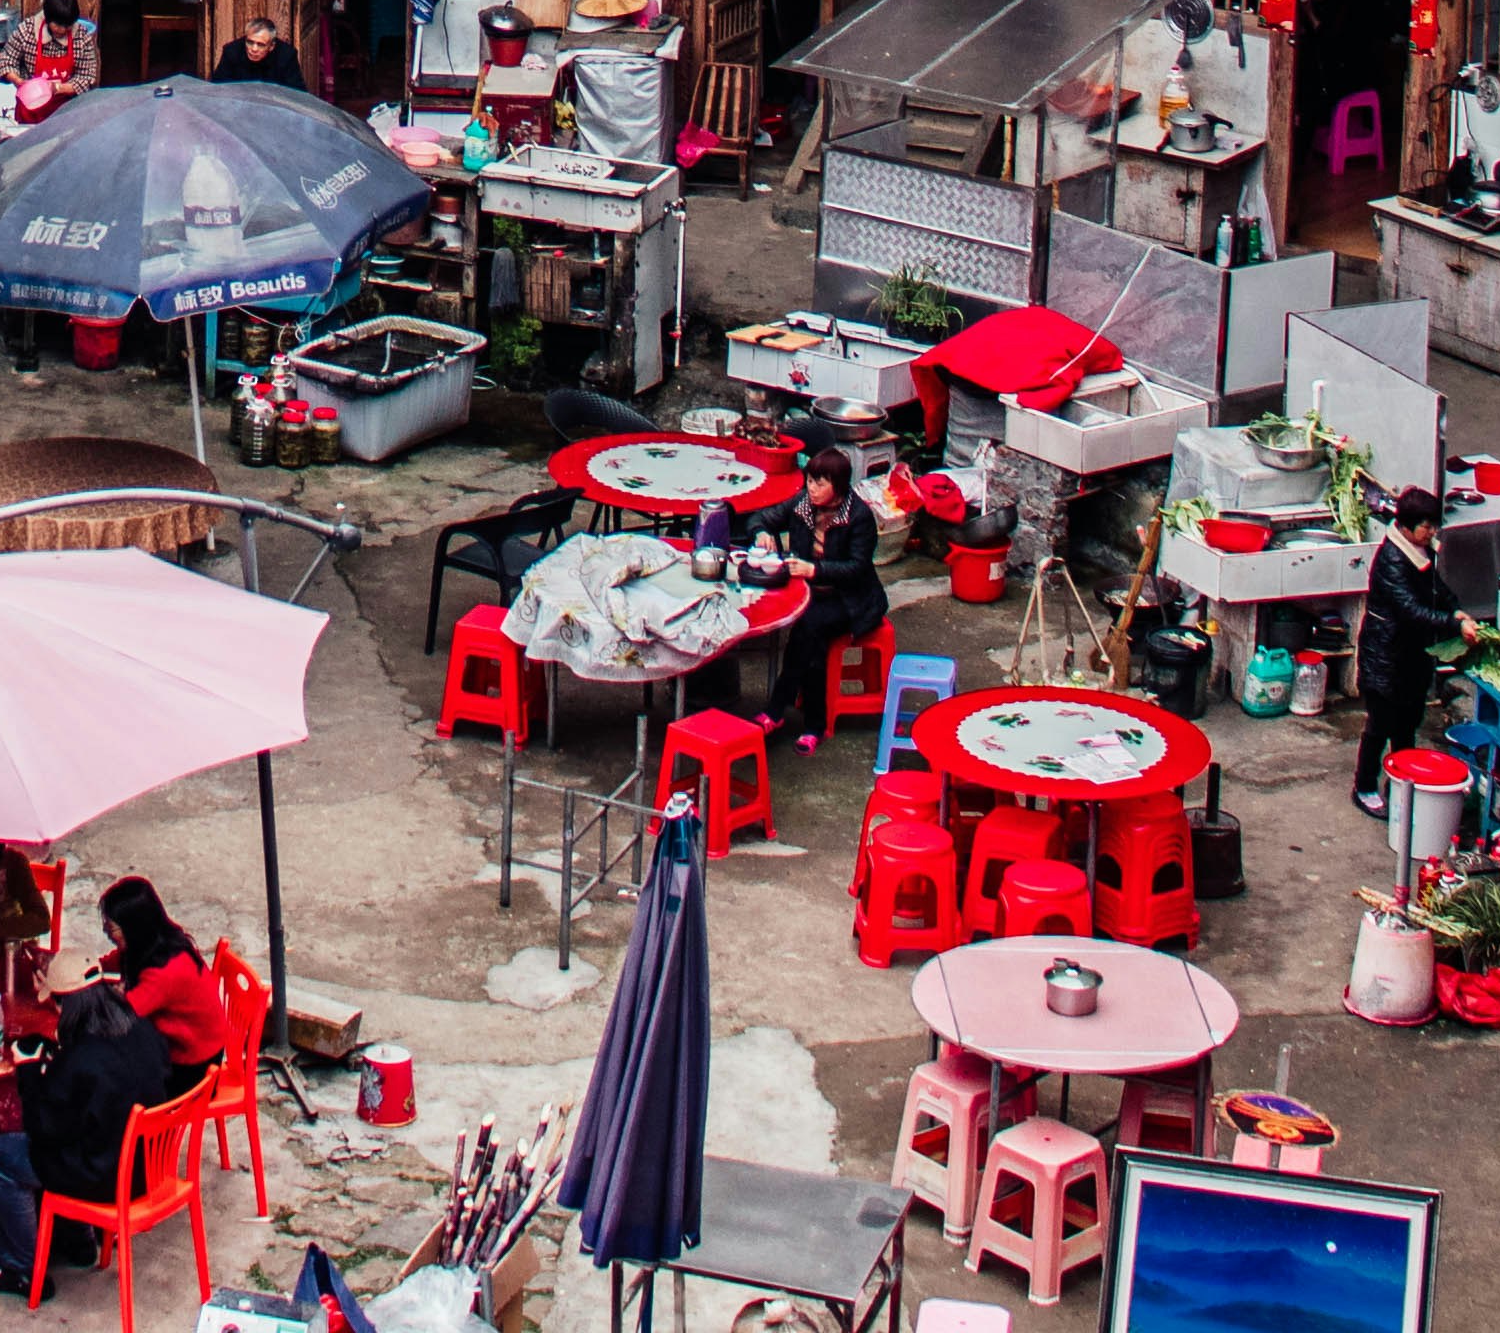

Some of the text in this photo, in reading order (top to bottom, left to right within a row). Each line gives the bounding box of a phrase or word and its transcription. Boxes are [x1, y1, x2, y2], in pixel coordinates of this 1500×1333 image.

[21, 215, 108, 251] 标致
[174, 272, 308, 312] 标致 Beautis
